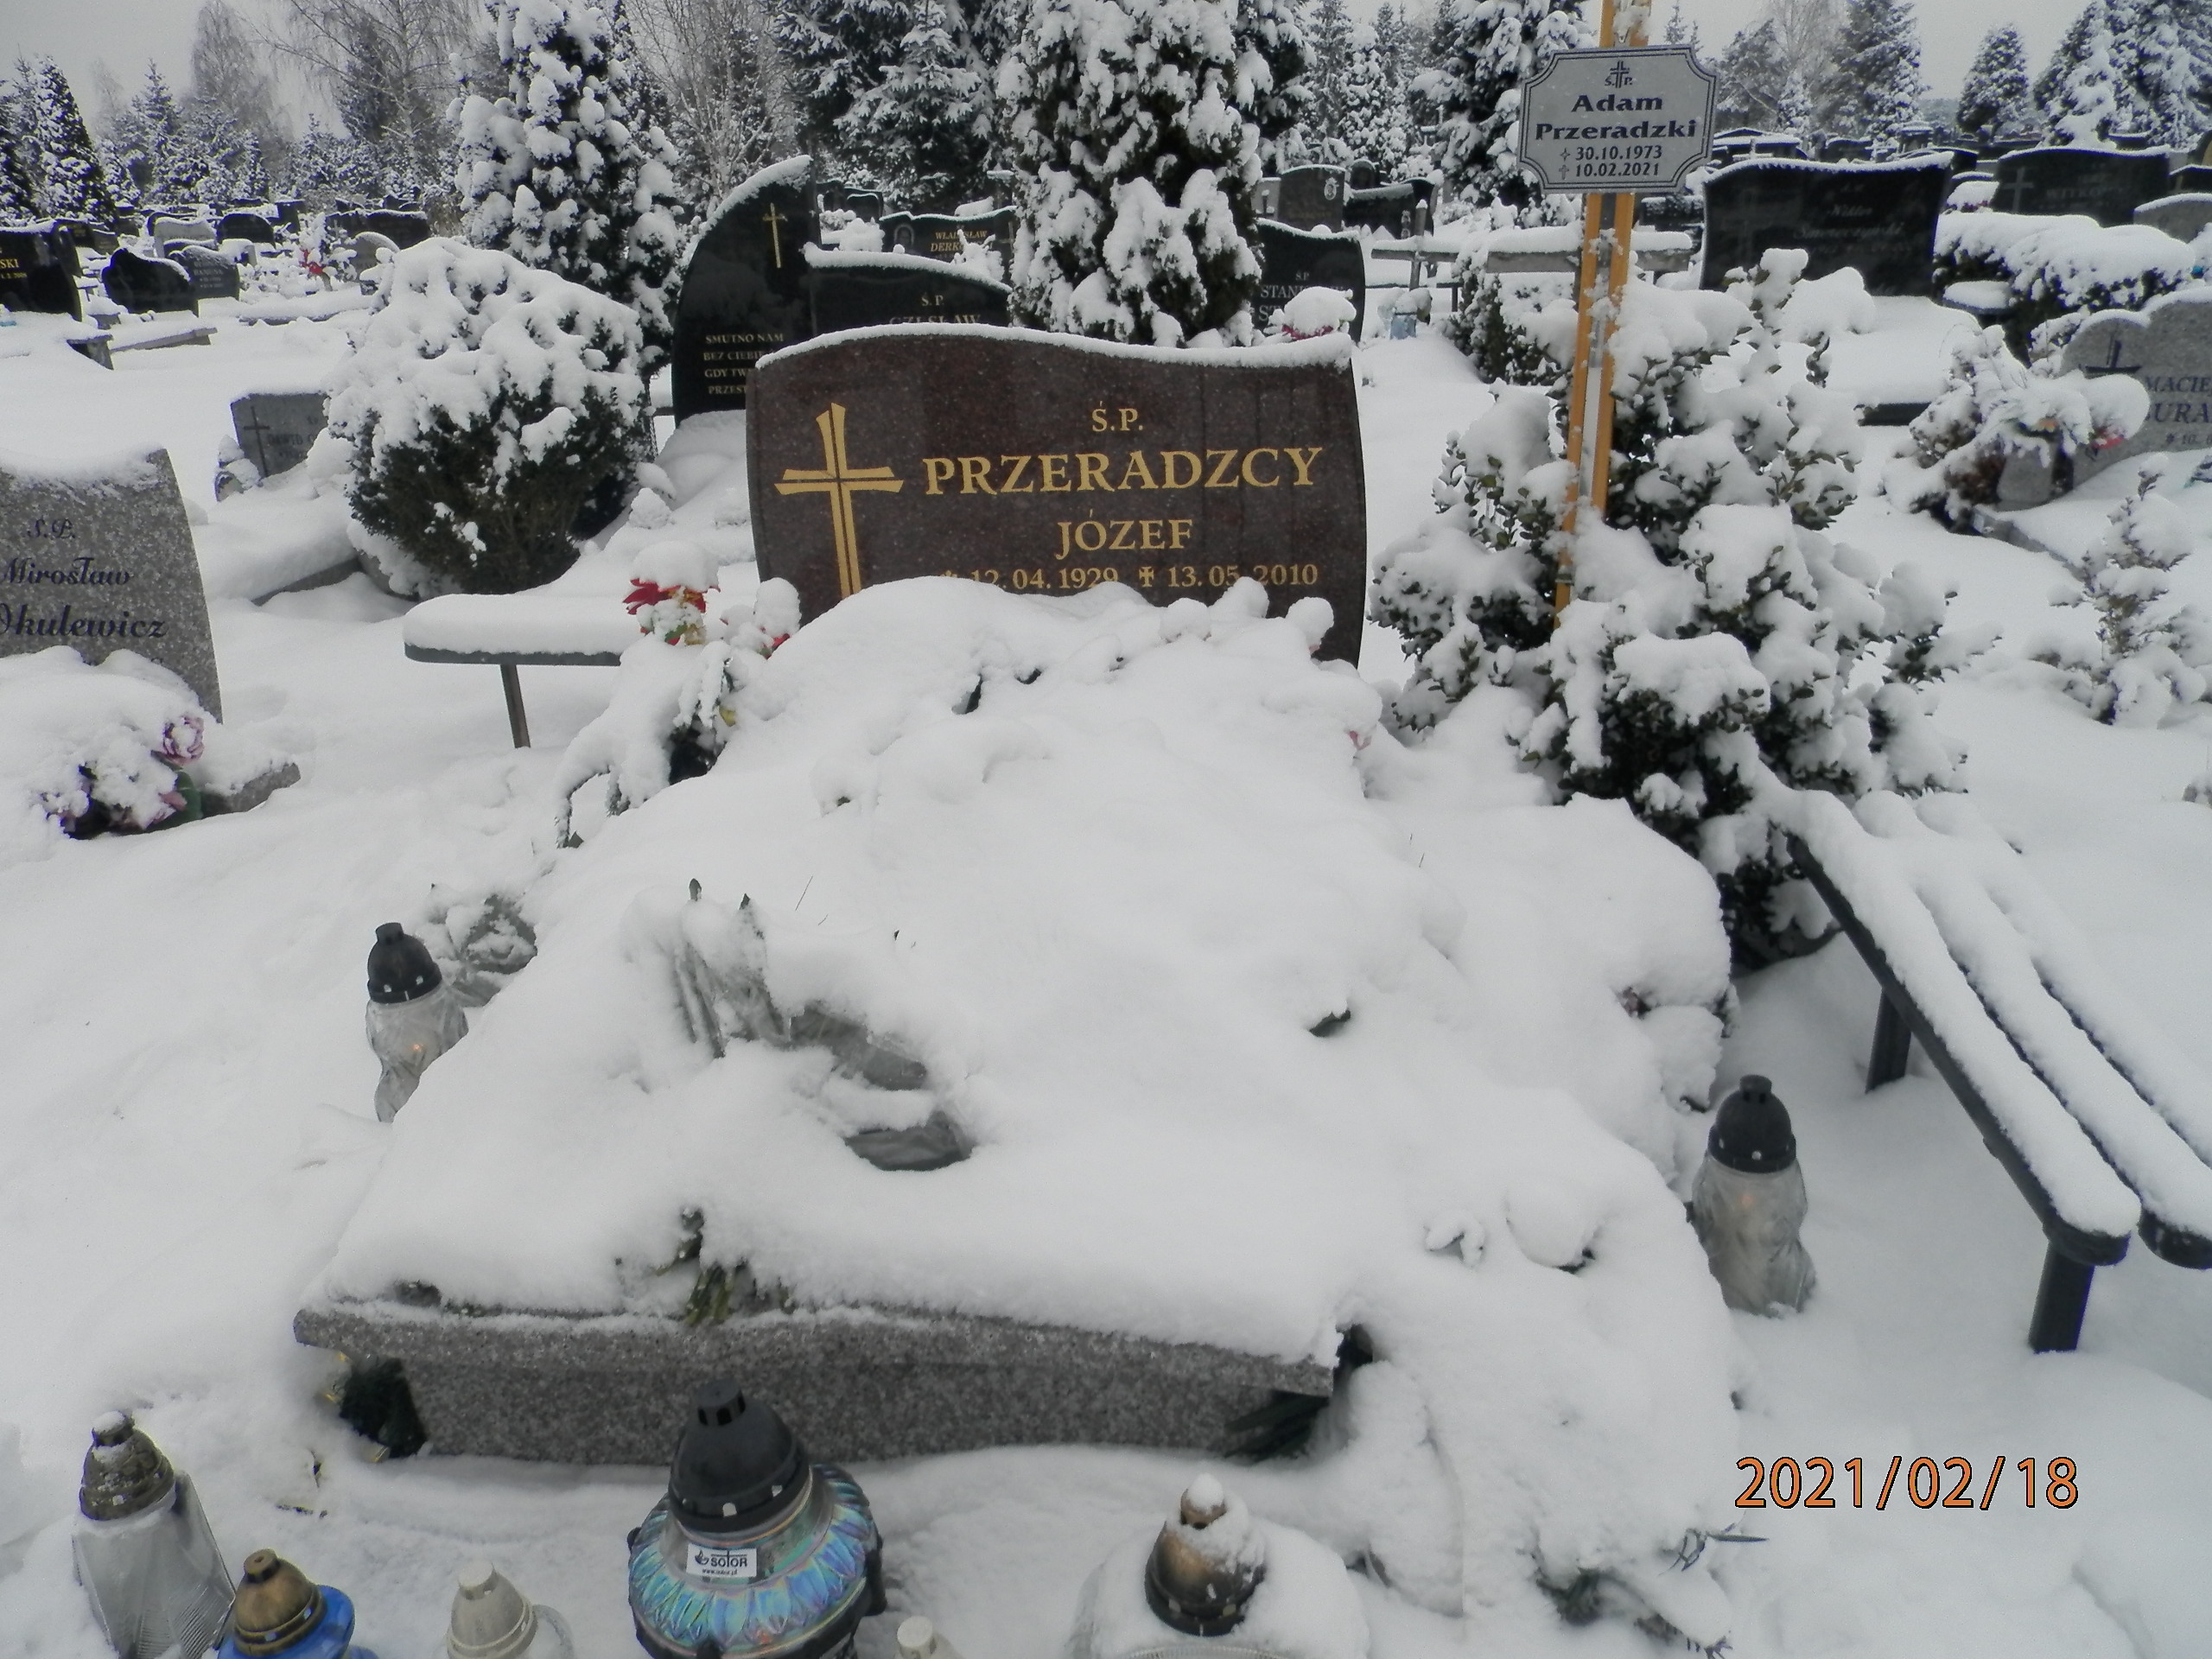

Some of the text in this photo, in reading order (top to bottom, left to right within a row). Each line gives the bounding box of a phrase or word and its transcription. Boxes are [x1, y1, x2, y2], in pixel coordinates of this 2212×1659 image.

[1571, 94, 1663, 112] Adam
[1535, 119, 1697, 143] Przeradzki
[1575, 145, 1662, 161] 30.10.1973
[1575, 162, 1659, 177] 10.02.2021
[705, 333, 784, 344] SMUTNO NAM
[703, 352, 724, 361] BEZ
[704, 368, 728, 378] GDY
[1091, 401, 1143, 432] Ś.P.
[922, 447, 1323, 495] PRZERADZCY
[1055, 509, 1193, 561] JÓZEF
[1, 556, 131, 586] Mirosław
